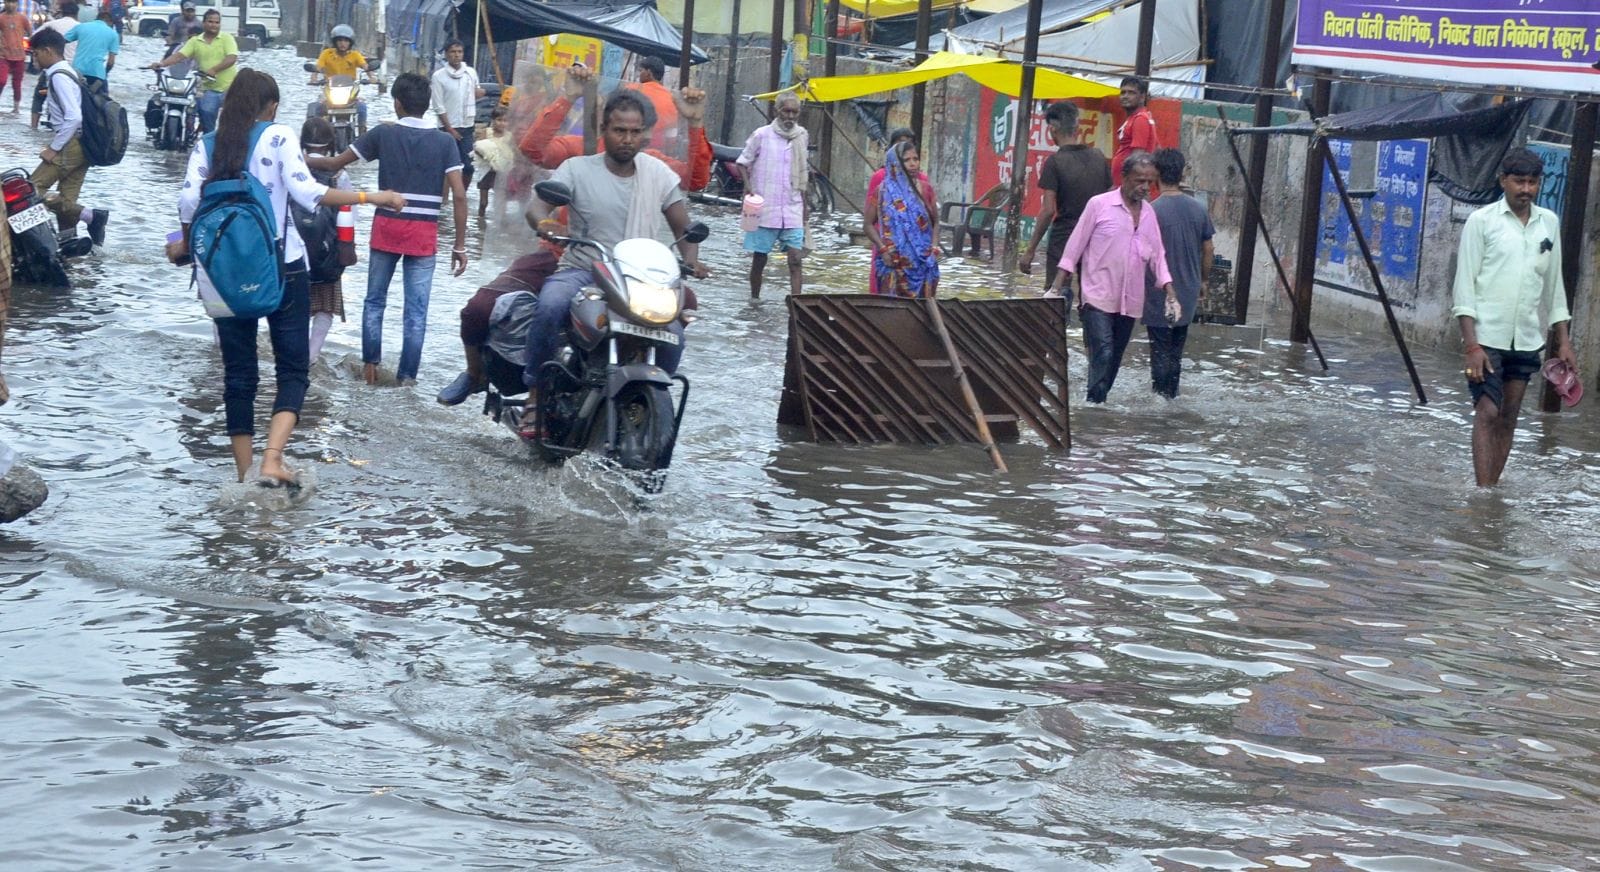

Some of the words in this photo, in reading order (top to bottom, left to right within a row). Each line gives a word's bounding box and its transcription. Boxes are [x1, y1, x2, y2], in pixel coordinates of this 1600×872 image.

[1323, 10, 1356, 38] निदान
[1356, 12, 1384, 40] पॉली
[1385, 15, 1434, 48] क्लीनिक,
[1438, 17, 1472, 46] निकट
[1473, 25, 1501, 47] बाल
[1502, 18, 1551, 49] निकेतन
[1552, 27, 1589, 59] स्कूल,
